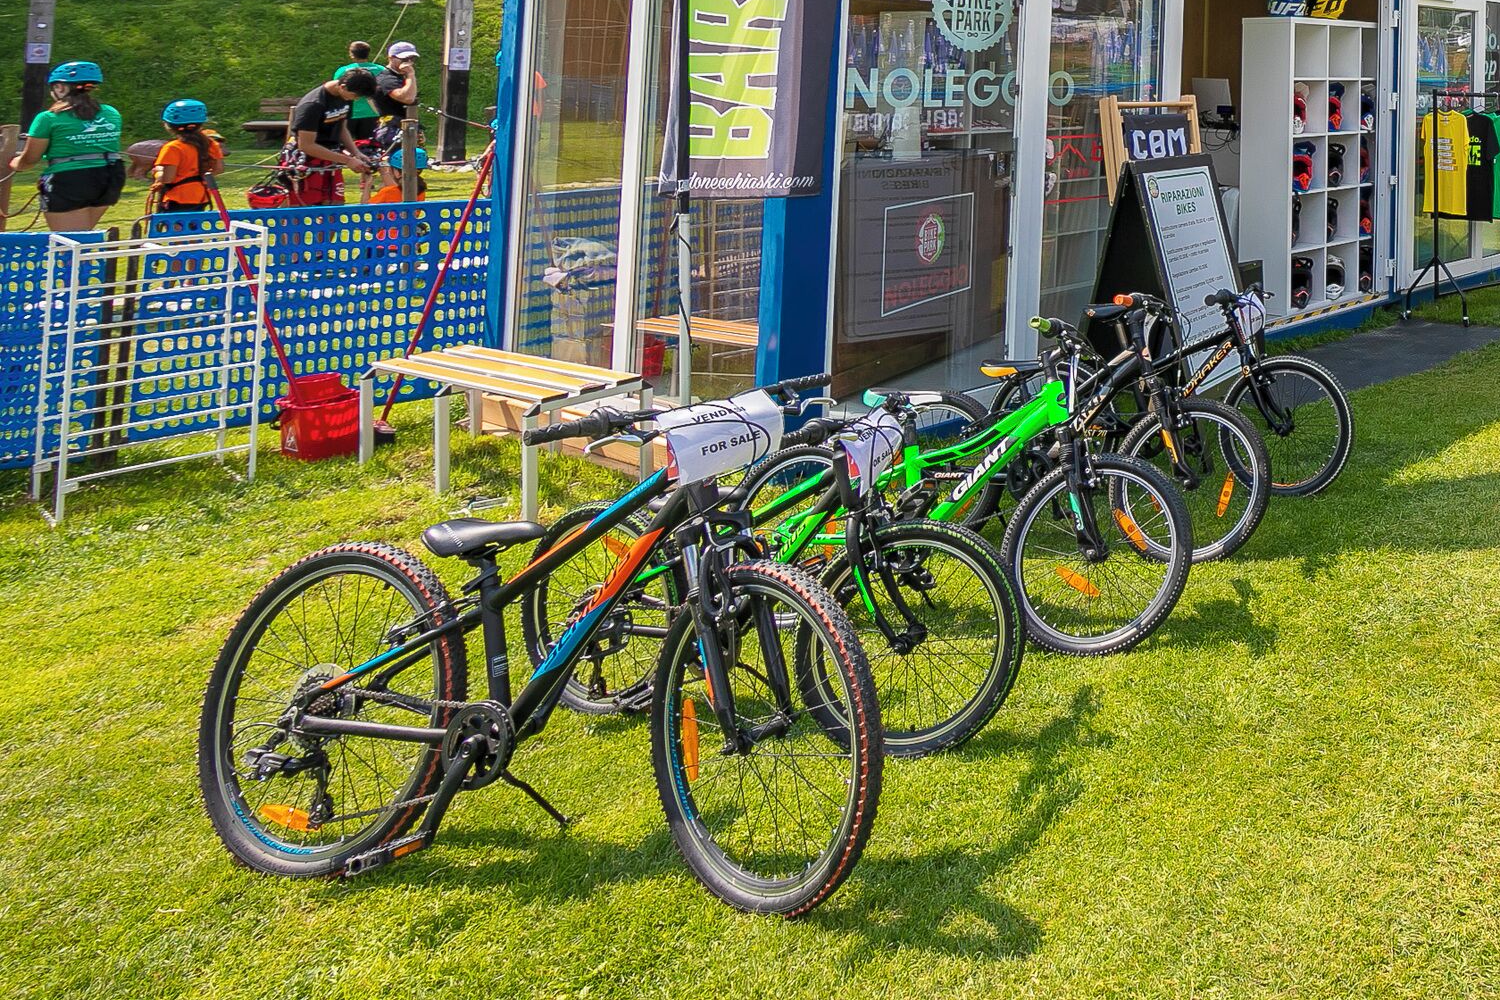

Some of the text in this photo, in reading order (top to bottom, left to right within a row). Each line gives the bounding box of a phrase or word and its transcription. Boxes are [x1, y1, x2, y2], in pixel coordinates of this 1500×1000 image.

[956, 10, 991, 32] PARK
[1160, 186, 1204, 203] RIPARAZIONI
[1176, 201, 1197, 215] BIKES
[924, 227, 938, 240] BIKE
[701, 430, 761, 457] FOR SALE
[952, 436, 1010, 501] GIANT
